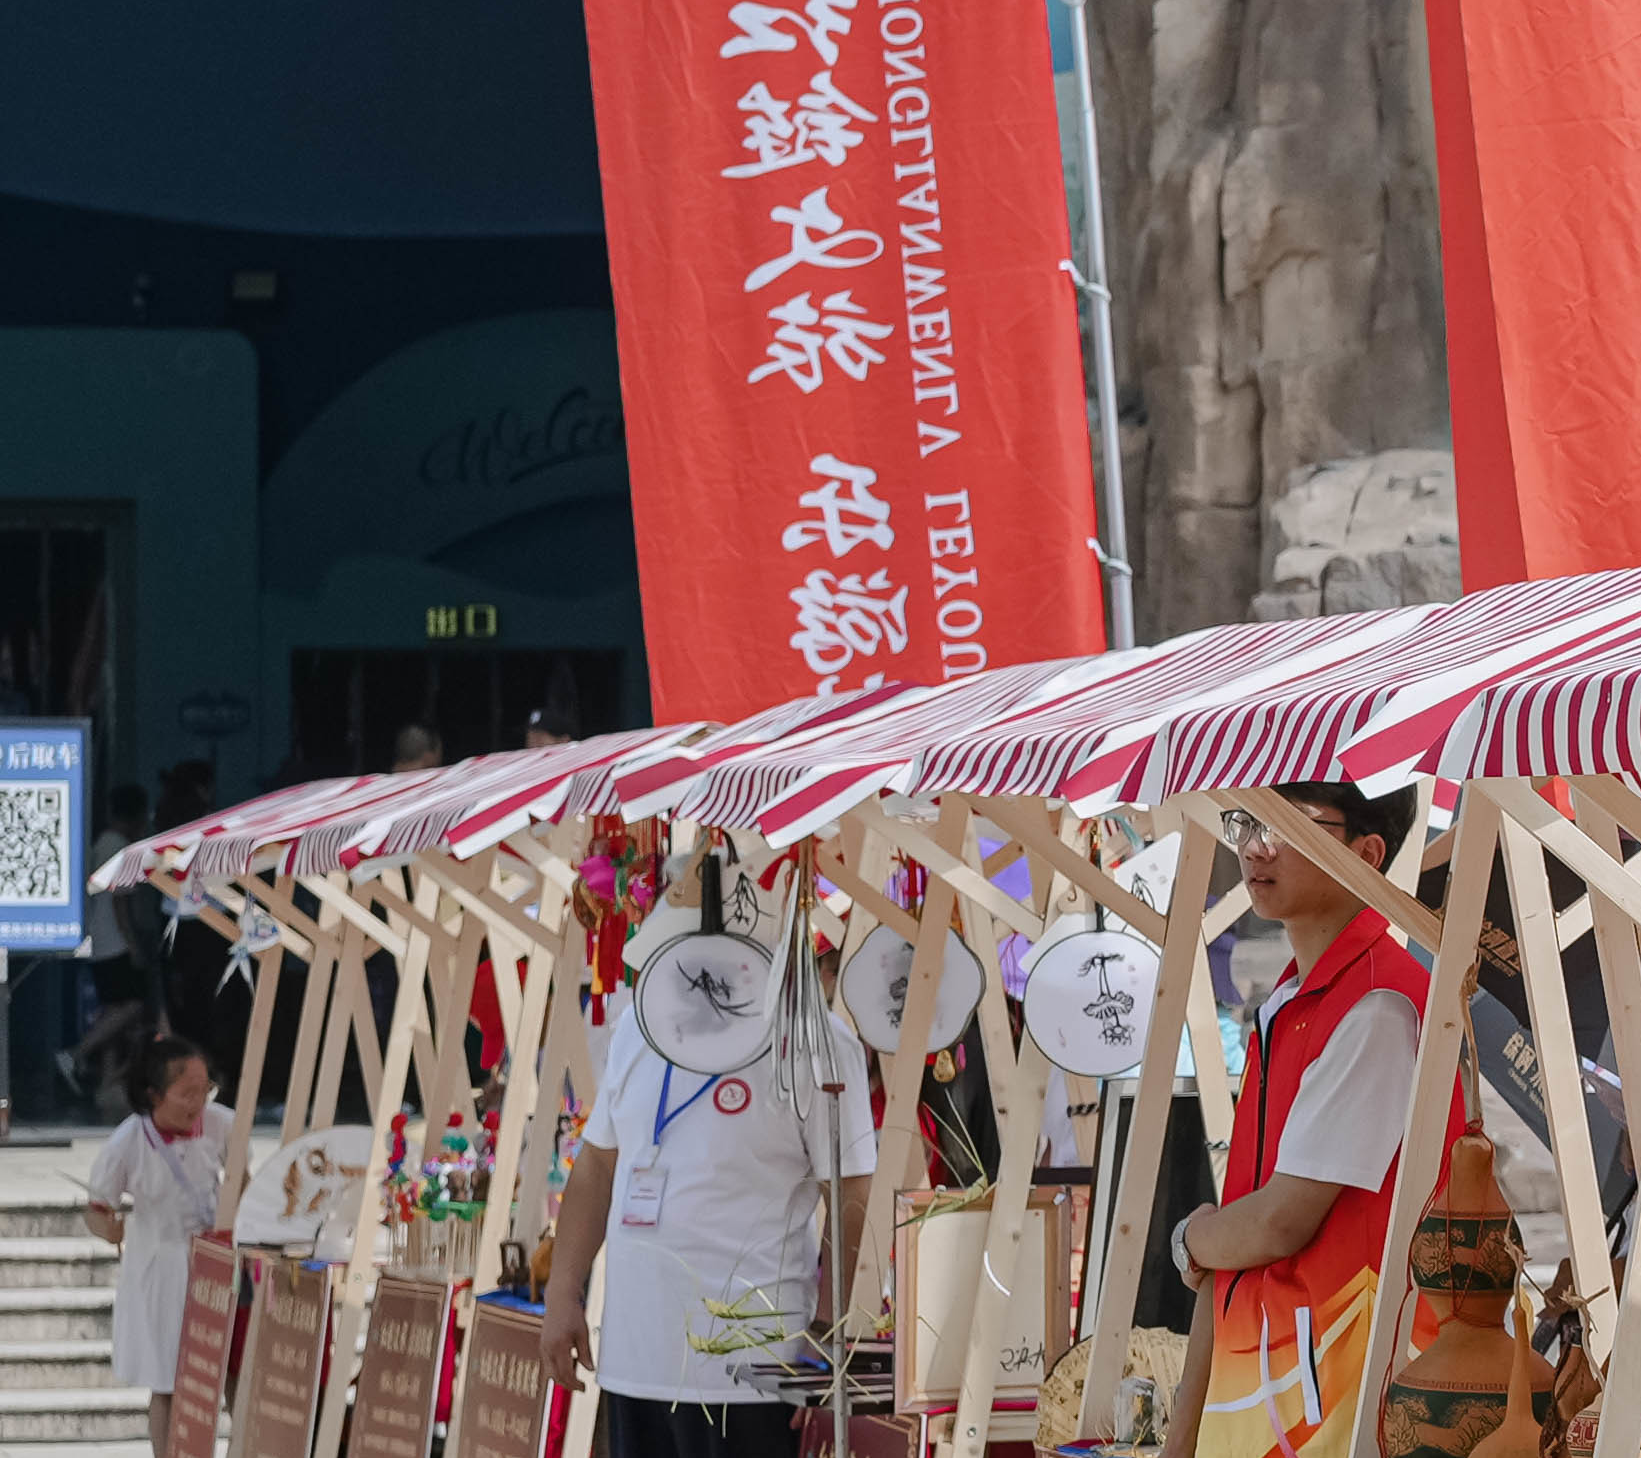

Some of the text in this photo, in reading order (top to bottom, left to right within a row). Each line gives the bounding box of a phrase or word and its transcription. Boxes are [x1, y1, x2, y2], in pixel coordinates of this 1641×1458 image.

[427, 605, 497, 639] 出口
[0, 741, 81, 770] 后取车
